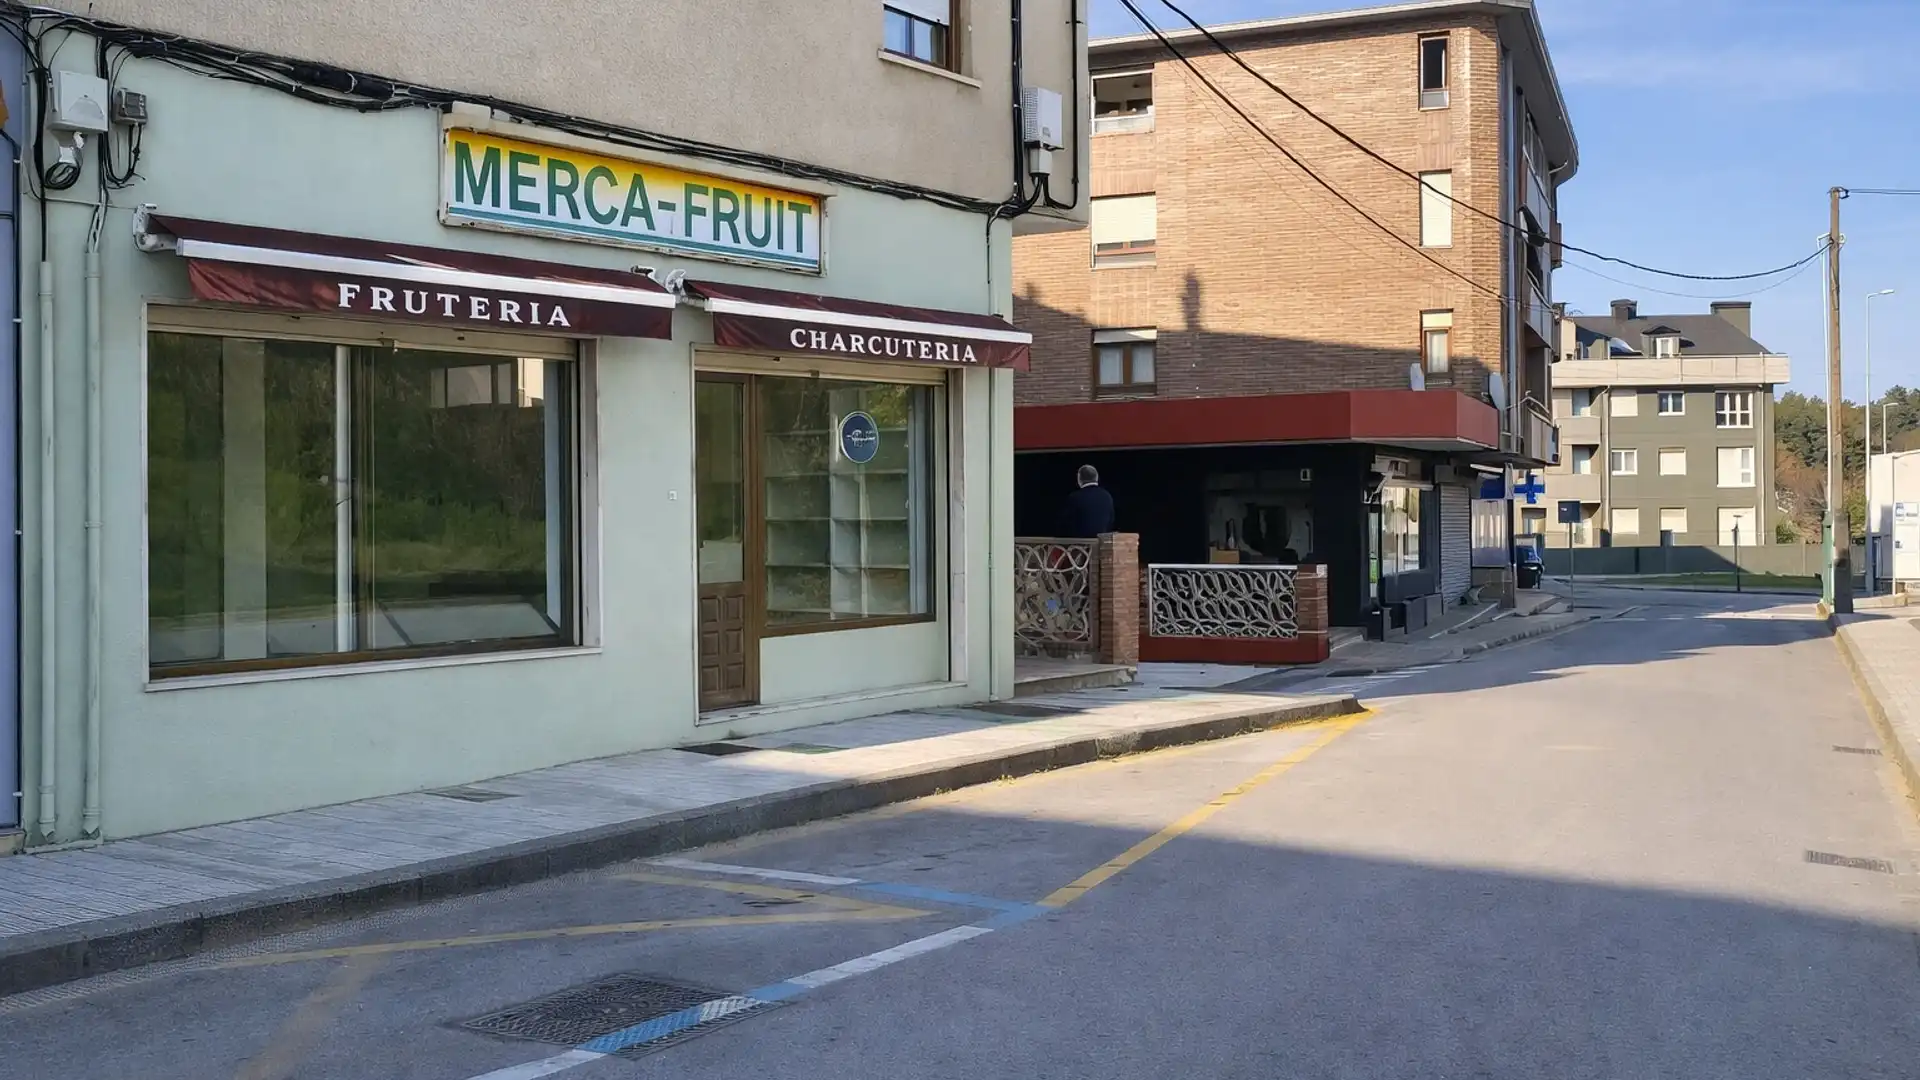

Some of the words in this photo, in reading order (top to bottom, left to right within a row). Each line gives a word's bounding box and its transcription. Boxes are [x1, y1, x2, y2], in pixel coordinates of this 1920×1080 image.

[455, 141, 812, 253] MERCA-FRUIT
[337, 283, 572, 328] FRUTERIA
[789, 328, 978, 363] CHARCUTERIA
